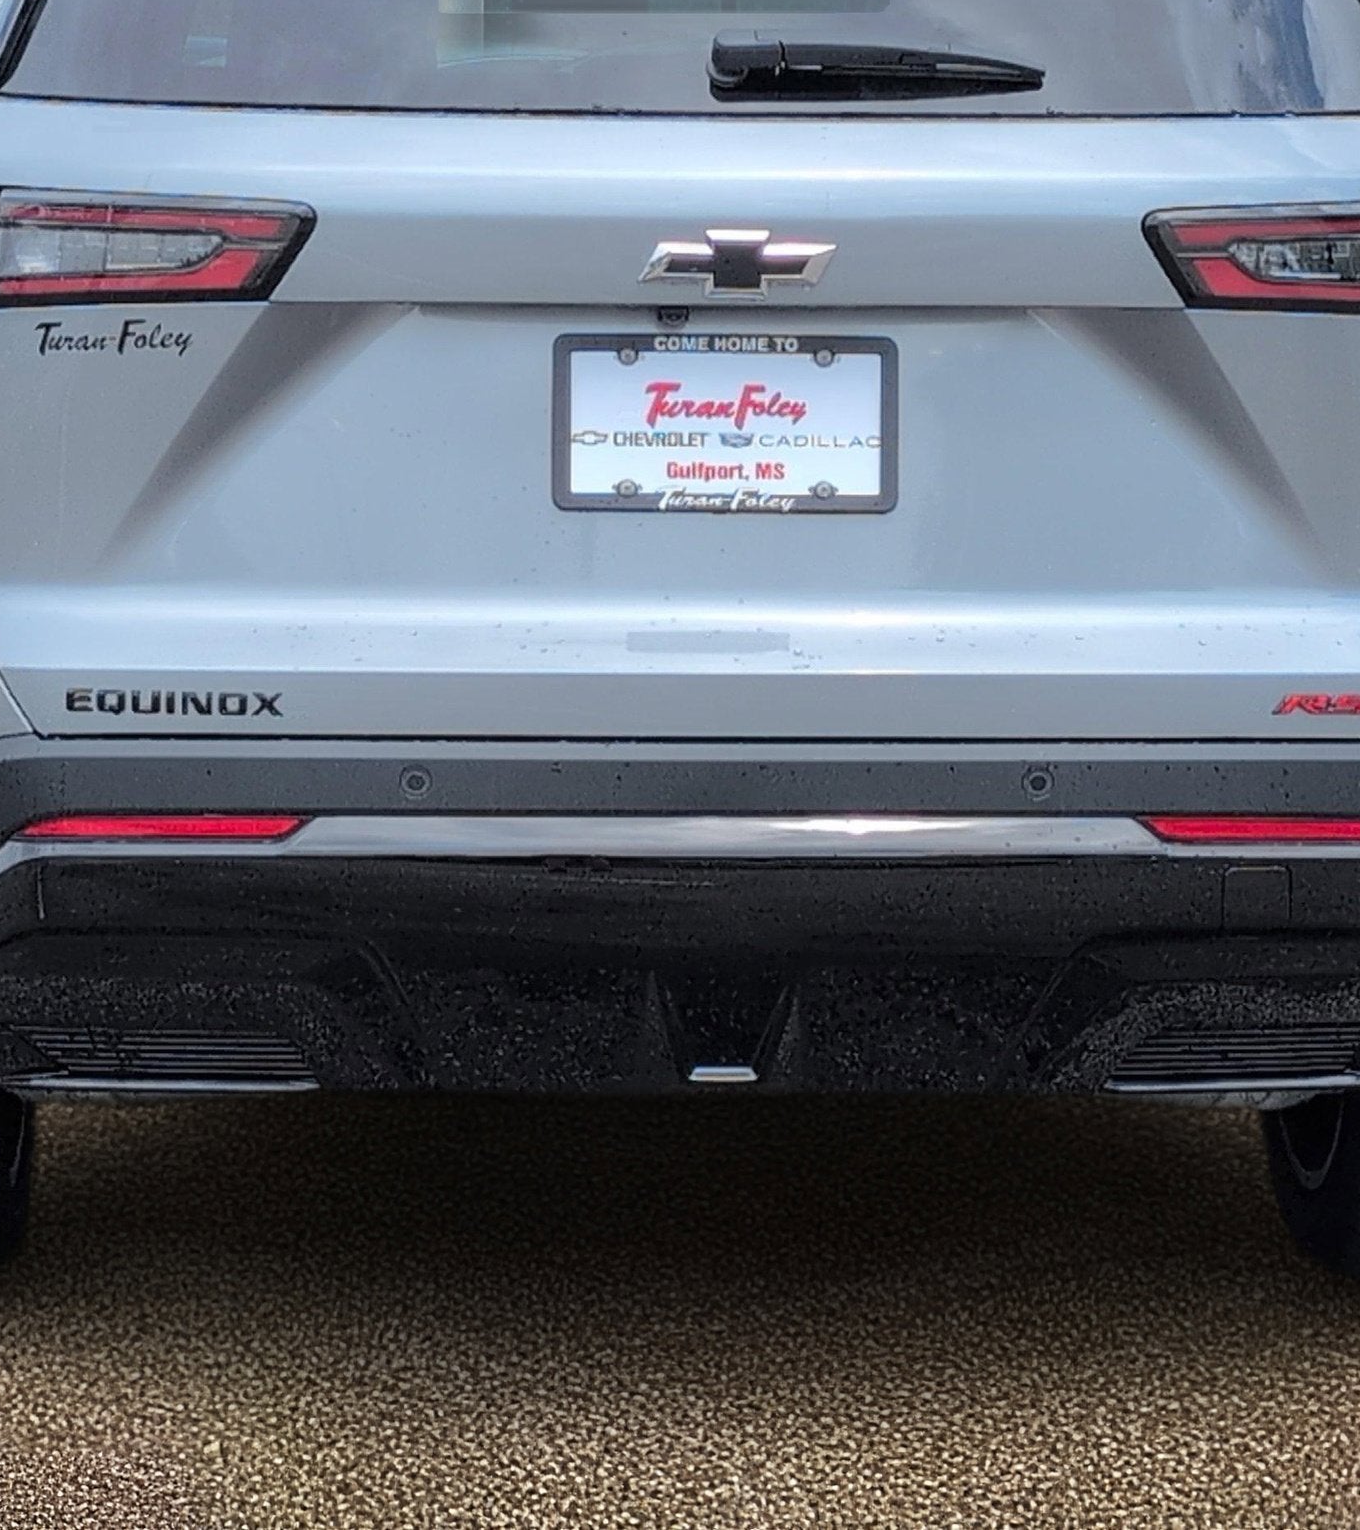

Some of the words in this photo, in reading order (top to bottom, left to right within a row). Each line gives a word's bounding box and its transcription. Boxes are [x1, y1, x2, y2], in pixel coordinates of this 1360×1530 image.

[654, 336, 710, 351] COME
[714, 336, 769, 352] HOME
[773, 337, 799, 352] TO
[613, 431, 707, 448] CHEVROLET
[758, 434, 882, 448] CADILLAC
[666, 461, 750, 482] Gulfport,
[755, 462, 785, 480] MS
[65, 688, 284, 717] EQUINOX
